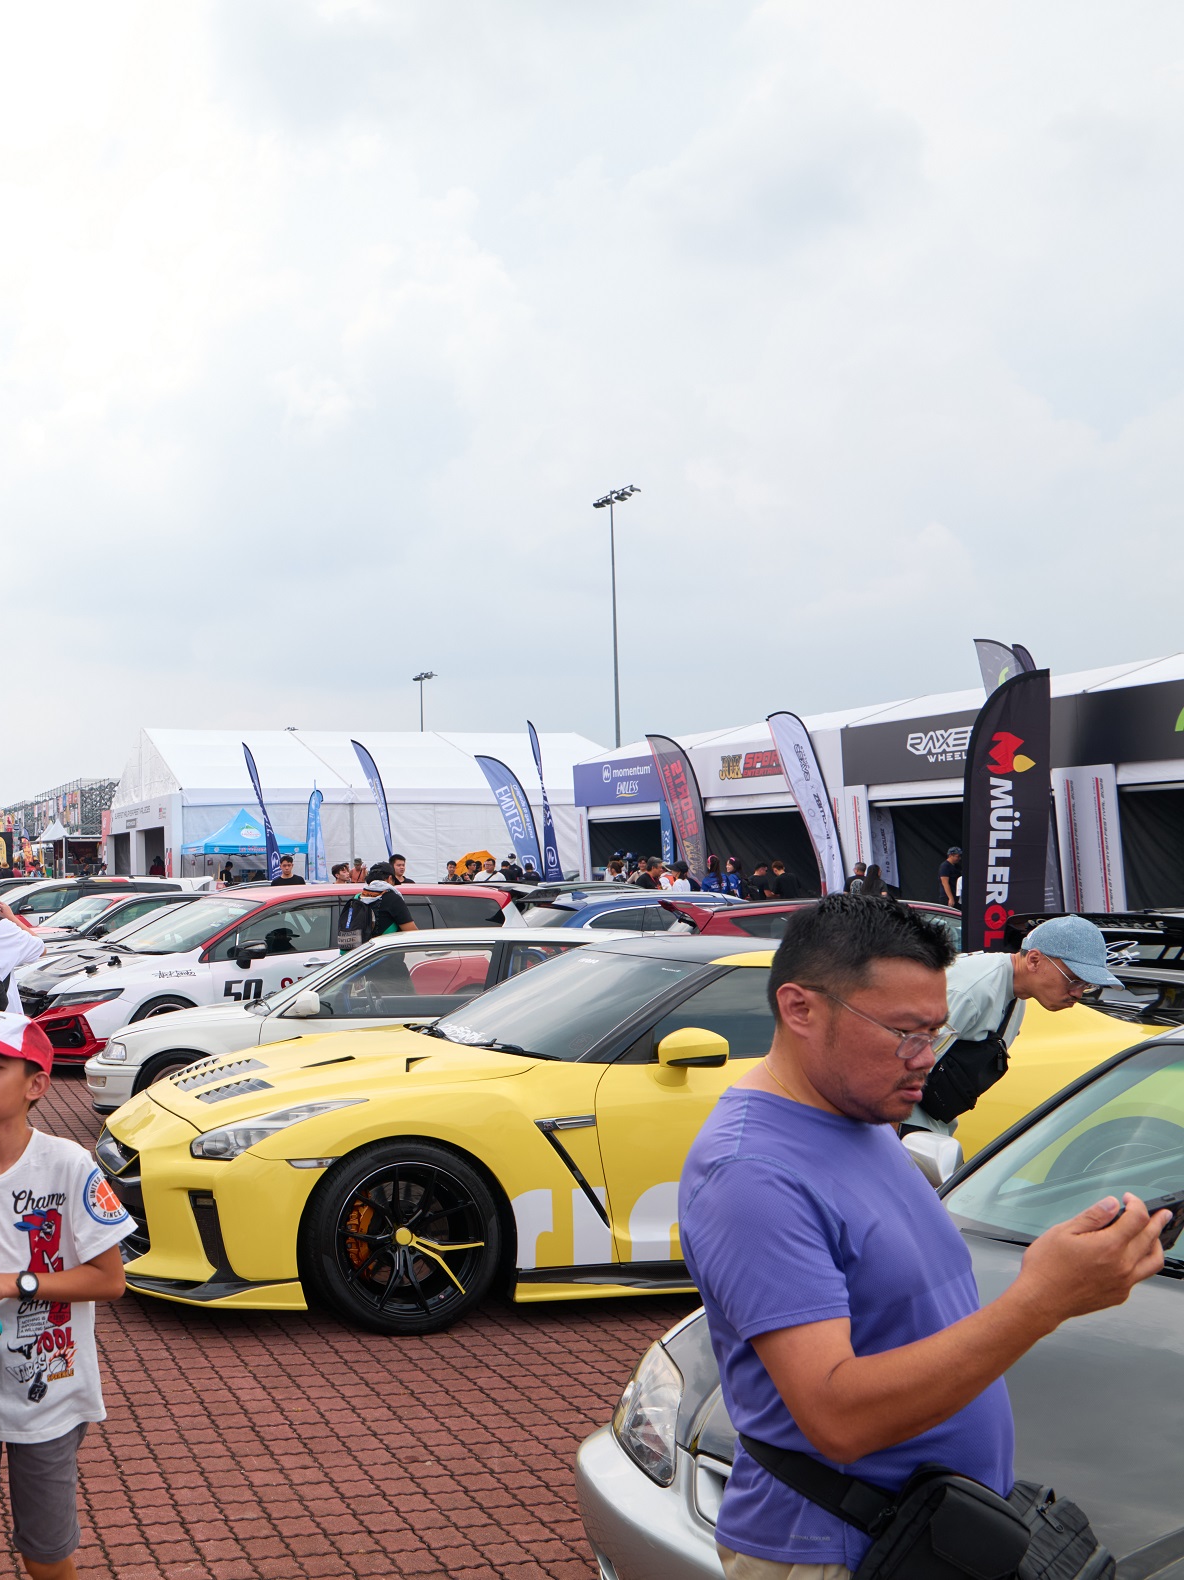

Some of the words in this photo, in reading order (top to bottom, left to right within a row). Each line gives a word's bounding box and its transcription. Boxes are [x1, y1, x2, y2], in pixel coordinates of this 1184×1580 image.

[907, 726, 974, 755] RAXE
[744, 750, 780, 768] SPOR
[927, 752, 968, 763] WHEEL
[613, 766, 651, 778] momentum
[616, 781, 639, 795] ENDLESS
[986, 777, 1021, 905] MÜLLER
[984, 905, 1015, 947] ÖL
[223, 978, 264, 1001] 50
[12, 1189, 66, 1215] Champ
[102, 1209, 121, 1218] SINCE
[6, 1352, 48, 1383] VIBES
